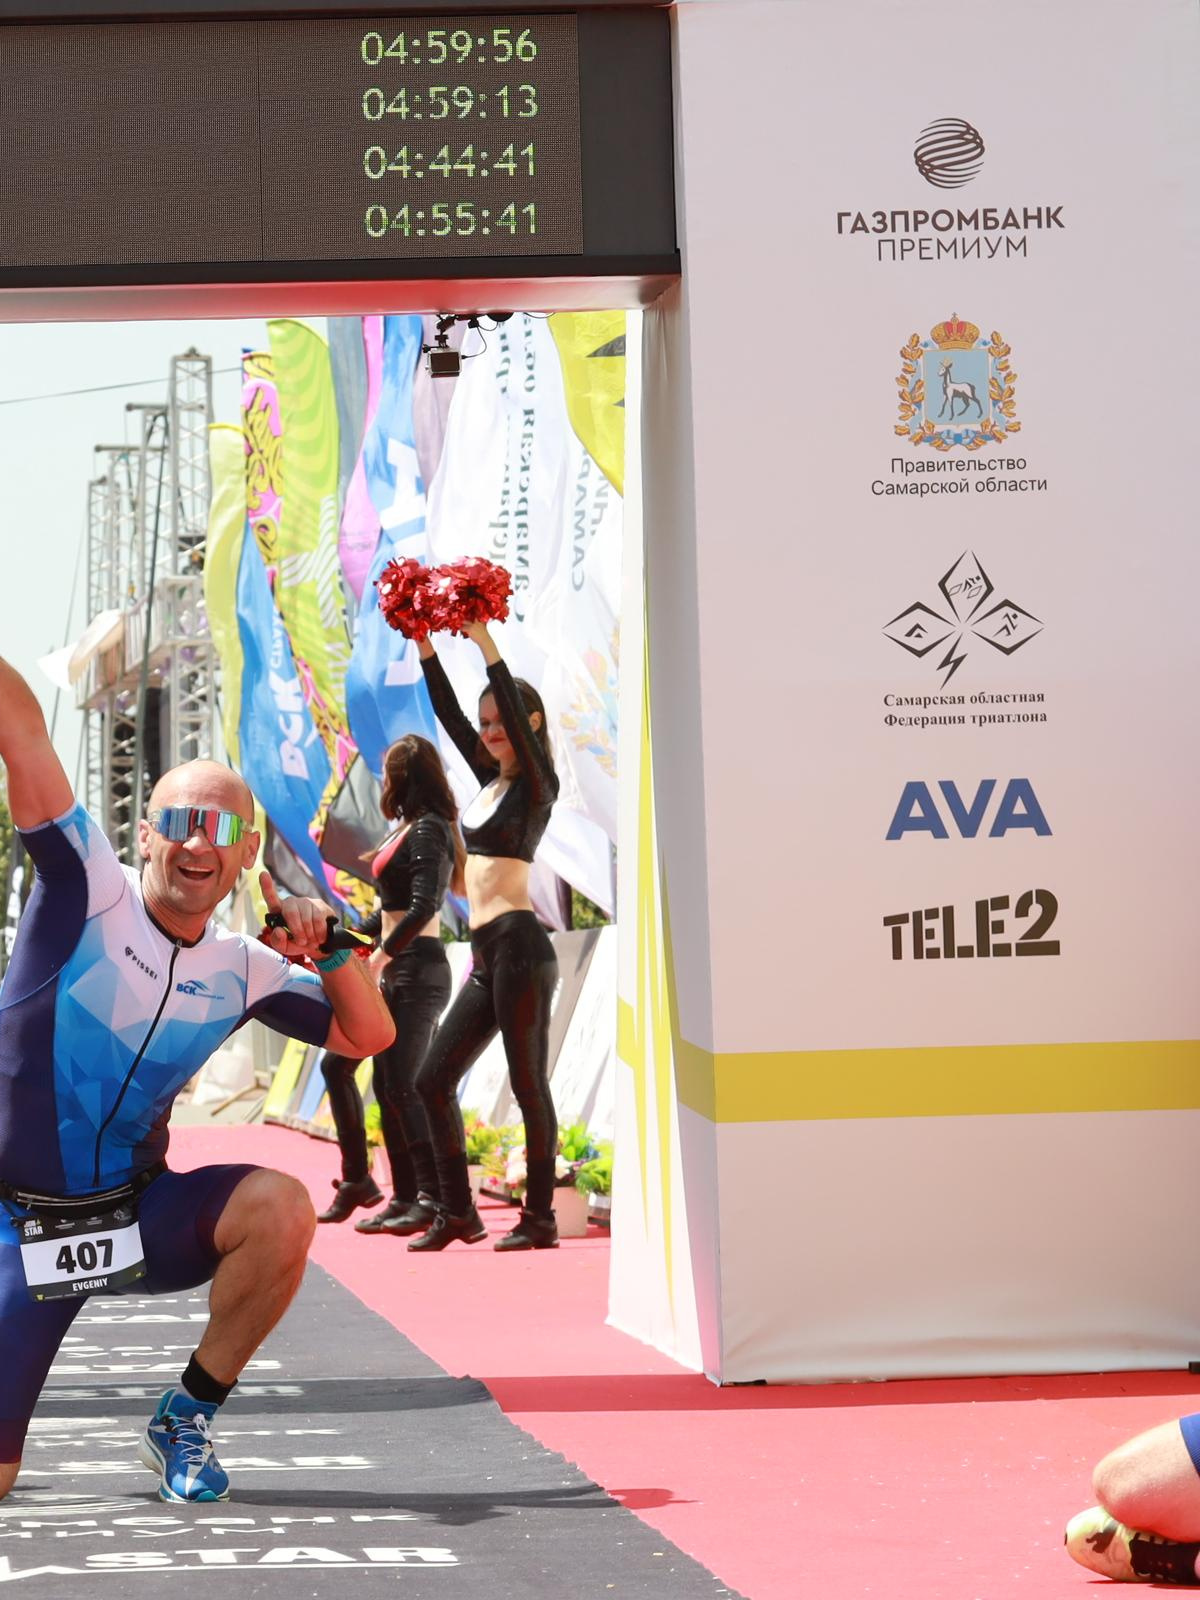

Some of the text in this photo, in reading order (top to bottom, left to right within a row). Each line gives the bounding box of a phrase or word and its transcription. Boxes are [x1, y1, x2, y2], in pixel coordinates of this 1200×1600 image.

[360, 28, 537, 65] 04:59:56
[362, 84, 539, 120] 04:59:13
[363, 142, 535, 179] 04:44:41
[365, 202, 536, 238] 04:55:41
[836, 205, 1065, 235] ГАЗПРОМБАНК
[877, 235, 1028, 262] ПРЕМИУМ
[891, 456, 1027, 476] Правительство
[871, 476, 1048, 498] Самарской области
[883, 690, 1045, 709] Самарская областная
[883, 711, 1048, 728] Федерация триатлона
[885, 777, 1053, 841] AVA
[882, 888, 1060, 961] TELE2
[131, 954, 159, 981] PISSEI
[55, 1238, 113, 1274] 407
[72, 1277, 109, 1292] EVGENIY
[56, 1455, 373, 1472] SAR
[83, 1547, 460, 1568] STAR
